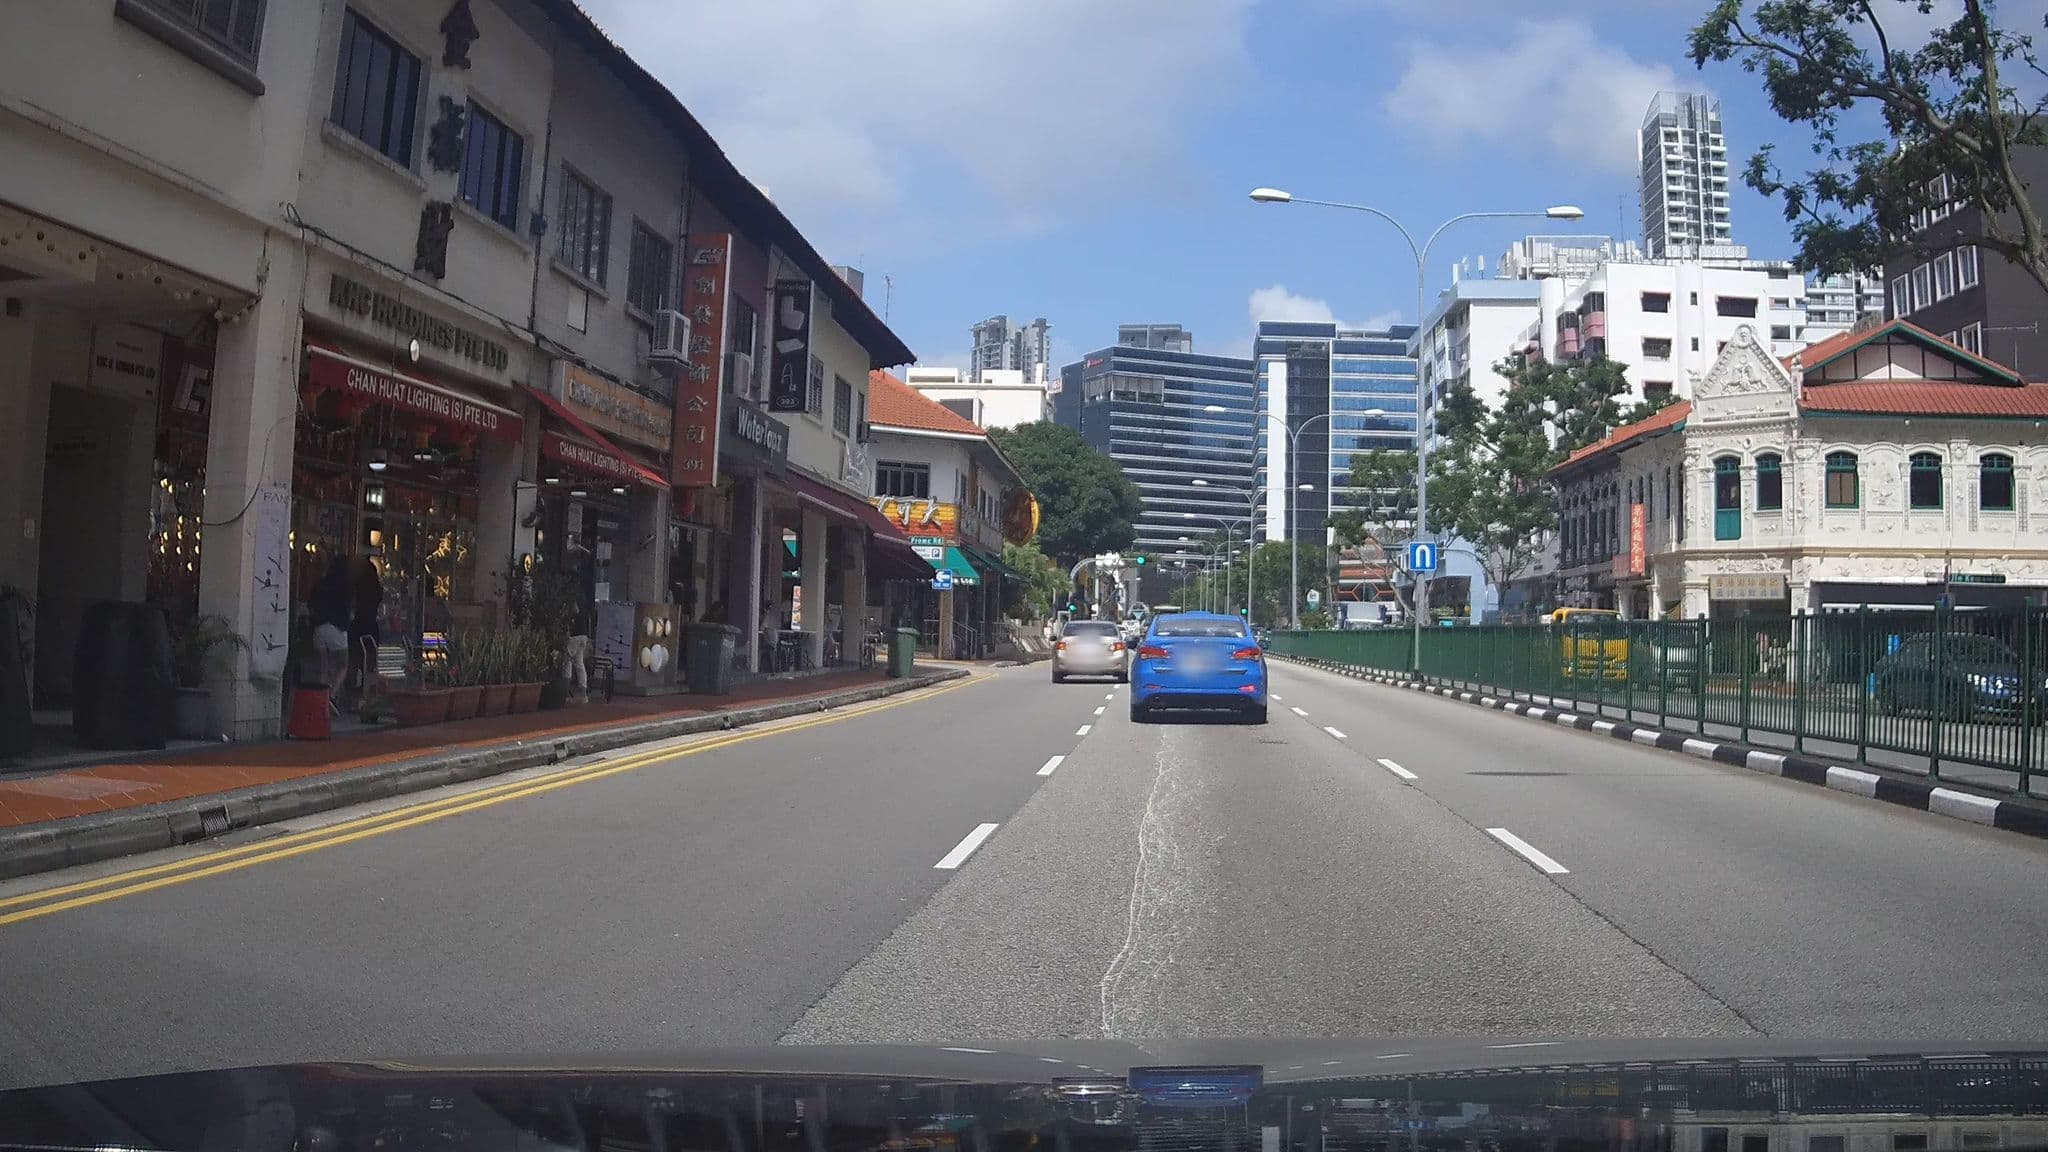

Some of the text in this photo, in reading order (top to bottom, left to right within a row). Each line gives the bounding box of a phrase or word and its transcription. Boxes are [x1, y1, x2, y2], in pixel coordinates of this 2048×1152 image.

[371, 292, 456, 353] HOLDINGS
[454, 327, 482, 362] PTE
[347, 369, 498, 429] CHAN HUAT LIGHTING (S) PTE LTD
[560, 441, 577, 460] CHAN
[577, 447, 593, 465] HUAT
[593, 452, 620, 472] LIGHTING
